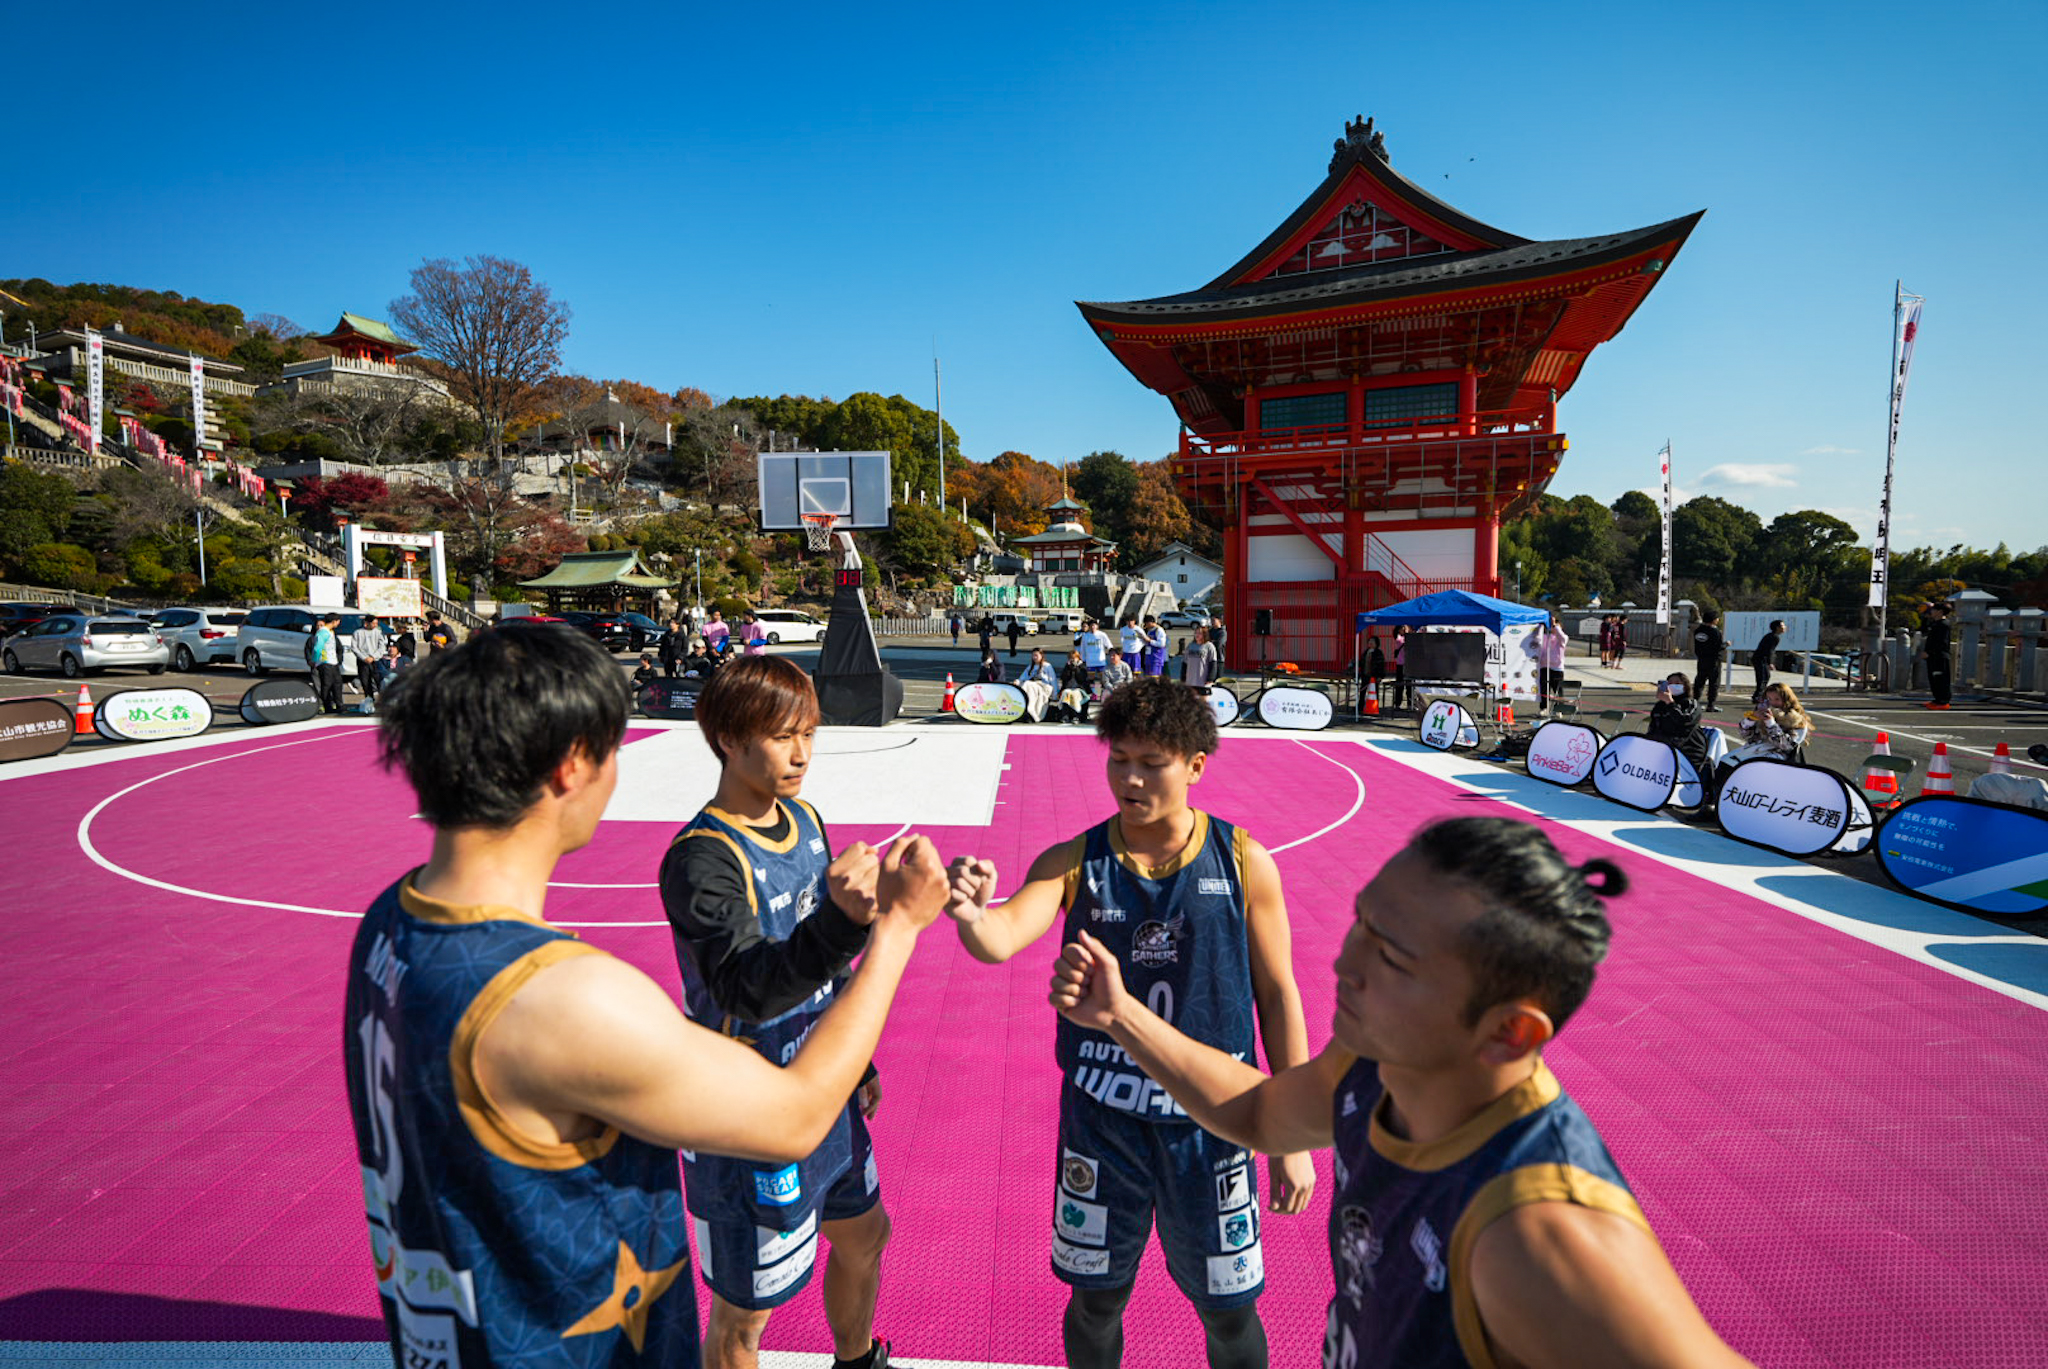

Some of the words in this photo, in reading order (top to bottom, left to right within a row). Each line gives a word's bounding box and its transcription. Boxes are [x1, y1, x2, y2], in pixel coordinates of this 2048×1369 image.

[128, 705, 191, 722] ぬく森
[1622, 763, 1671, 787] OLDBASE
[1723, 786, 1843, 829] 犬山ローレライ麦酒
[1074, 1065, 1189, 1116] WOR
